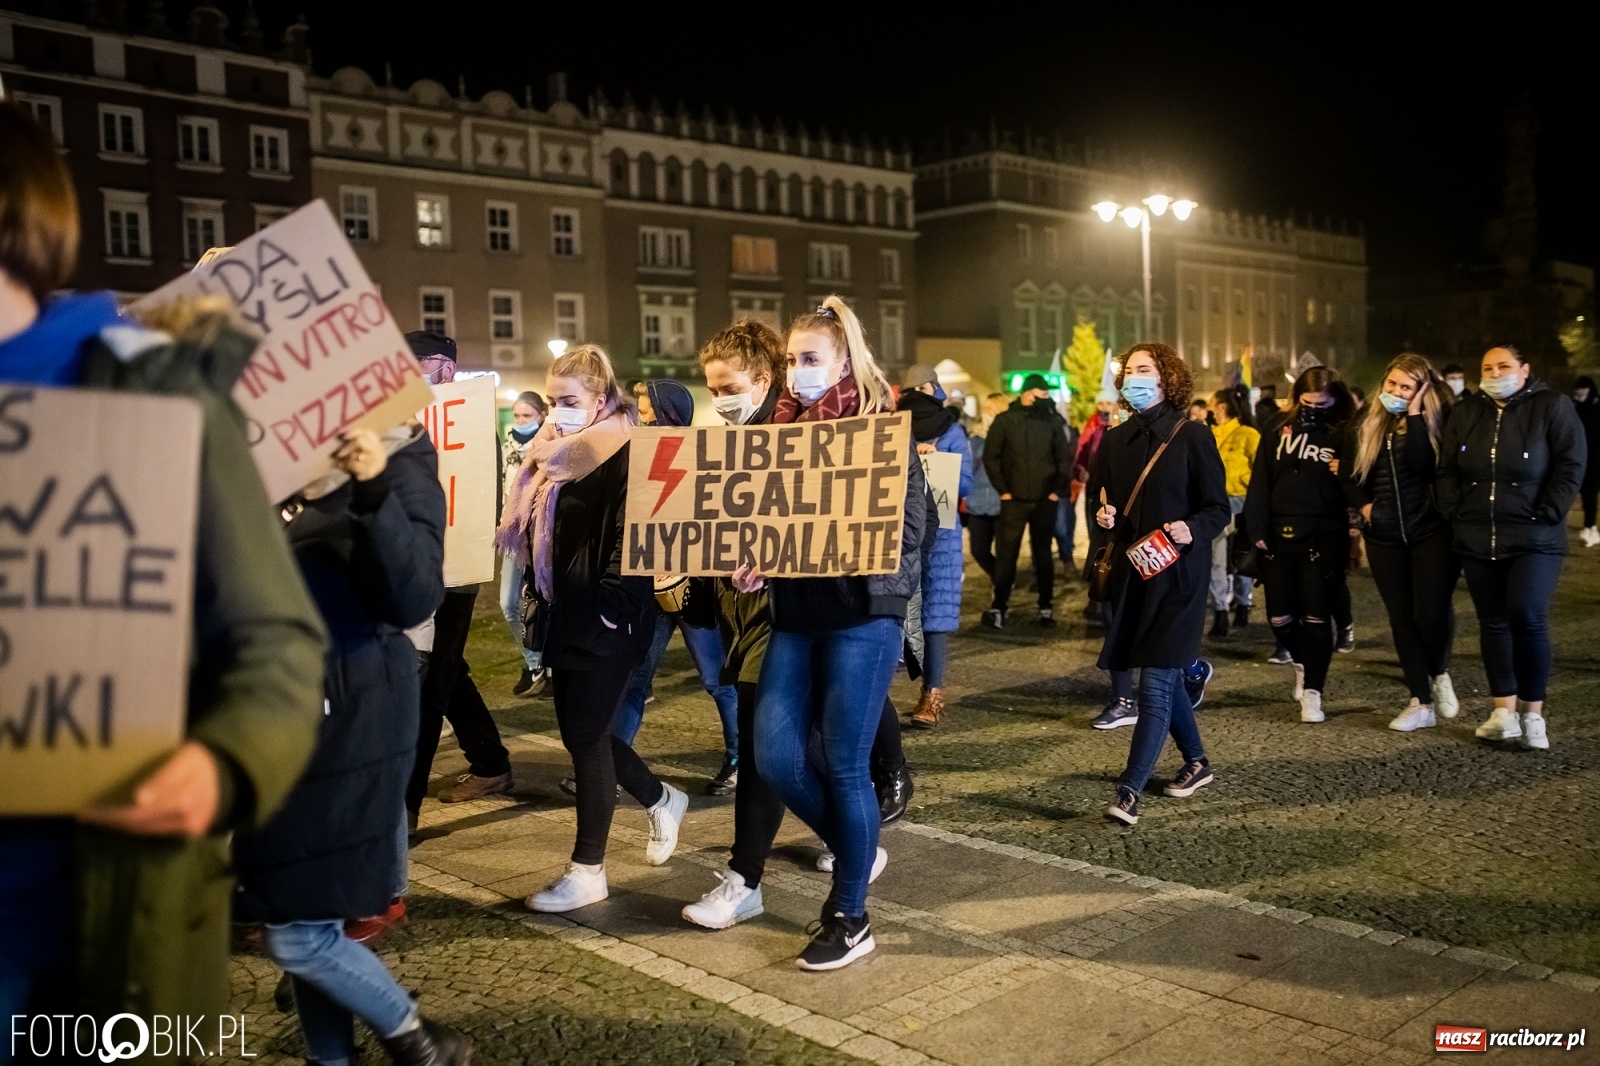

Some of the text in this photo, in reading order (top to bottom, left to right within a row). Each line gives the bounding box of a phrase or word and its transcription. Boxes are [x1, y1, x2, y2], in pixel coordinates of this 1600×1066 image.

[240, 291, 386, 399] IN VITRO
[269, 349, 422, 463] PIZZERIA
[628, 520, 900, 575] WYPIERDALAJTE
